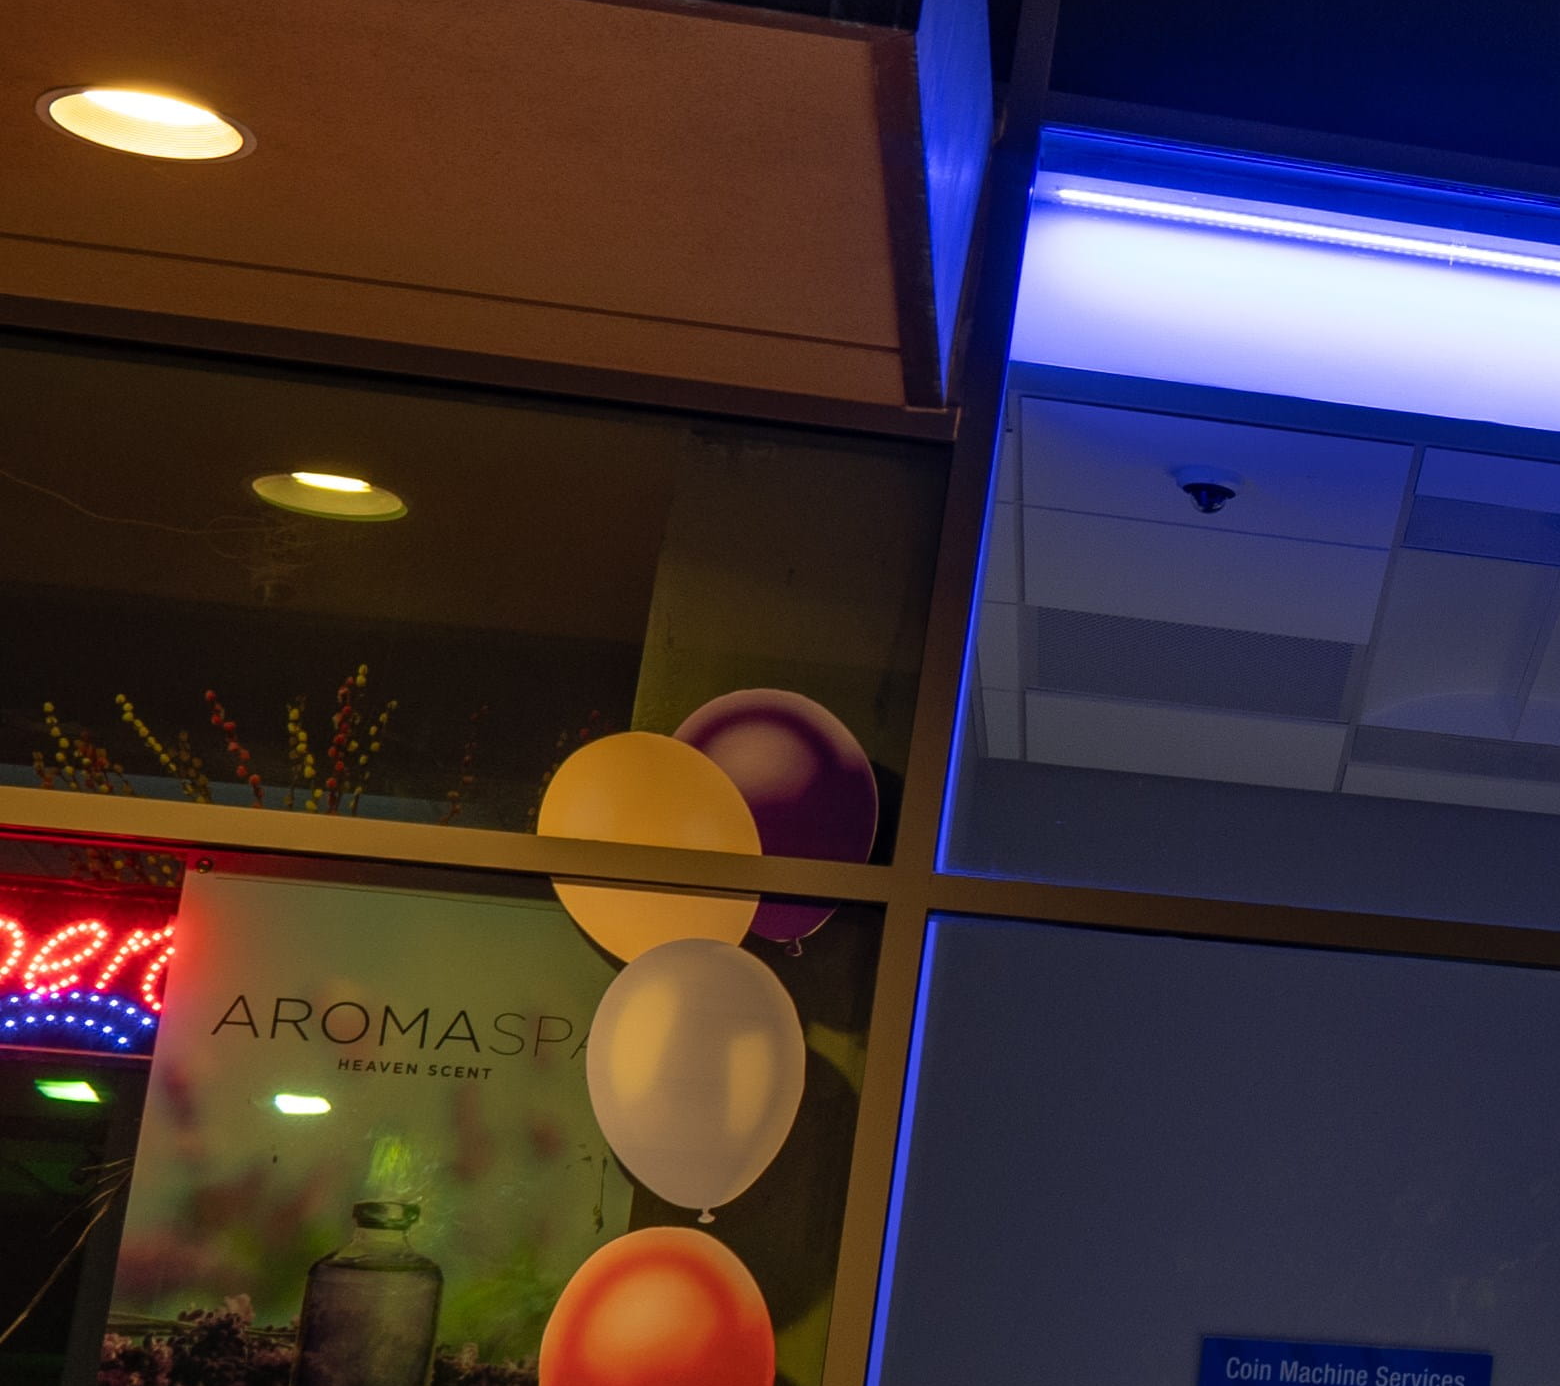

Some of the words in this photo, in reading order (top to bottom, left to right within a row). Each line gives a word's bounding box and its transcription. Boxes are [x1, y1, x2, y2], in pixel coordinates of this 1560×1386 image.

[338, 1059, 418, 1075] HEAVEN
[427, 1065, 492, 1080] SCENT
[1226, 1357, 1272, 1382] Coin
[1280, 1360, 1369, 1386] Machine
